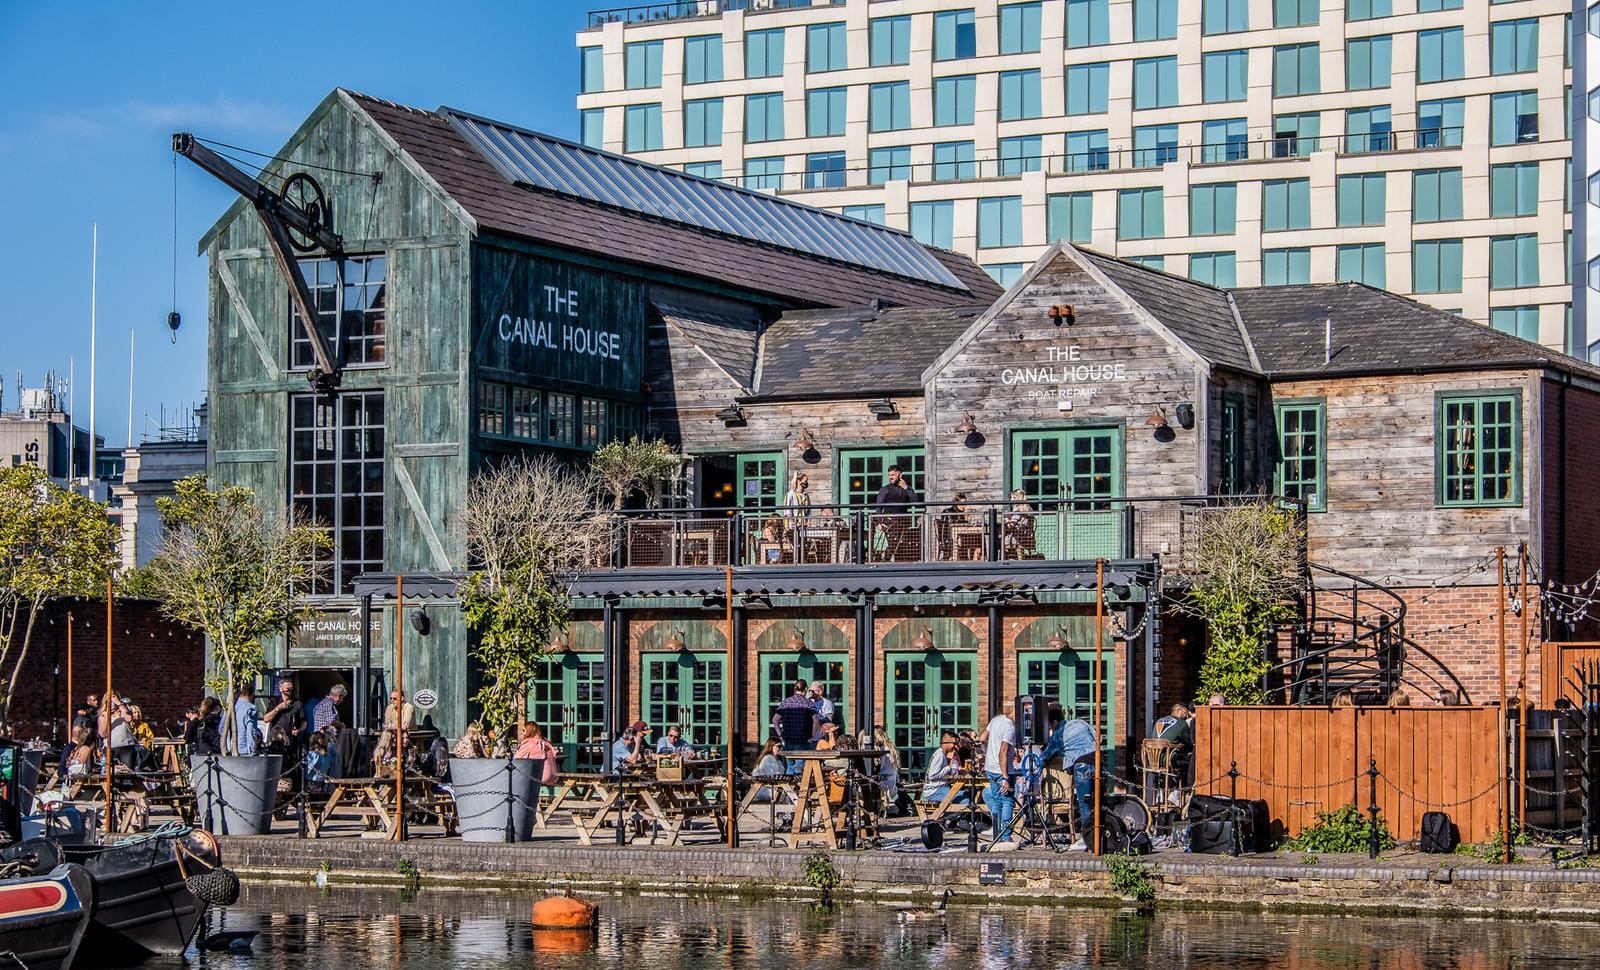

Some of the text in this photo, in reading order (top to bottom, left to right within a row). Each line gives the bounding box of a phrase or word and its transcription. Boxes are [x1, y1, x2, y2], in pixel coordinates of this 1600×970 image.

[543, 285, 579, 317] THE
[498, 313, 620, 360] CANAL HOUSE
[1045, 345, 1081, 362] THE
[1001, 363, 1126, 385] CANAL HOUSE
[1028, 387, 1098, 401] BOAT REPAIR
[299, 620, 381, 631] THE CANAL HOSE
